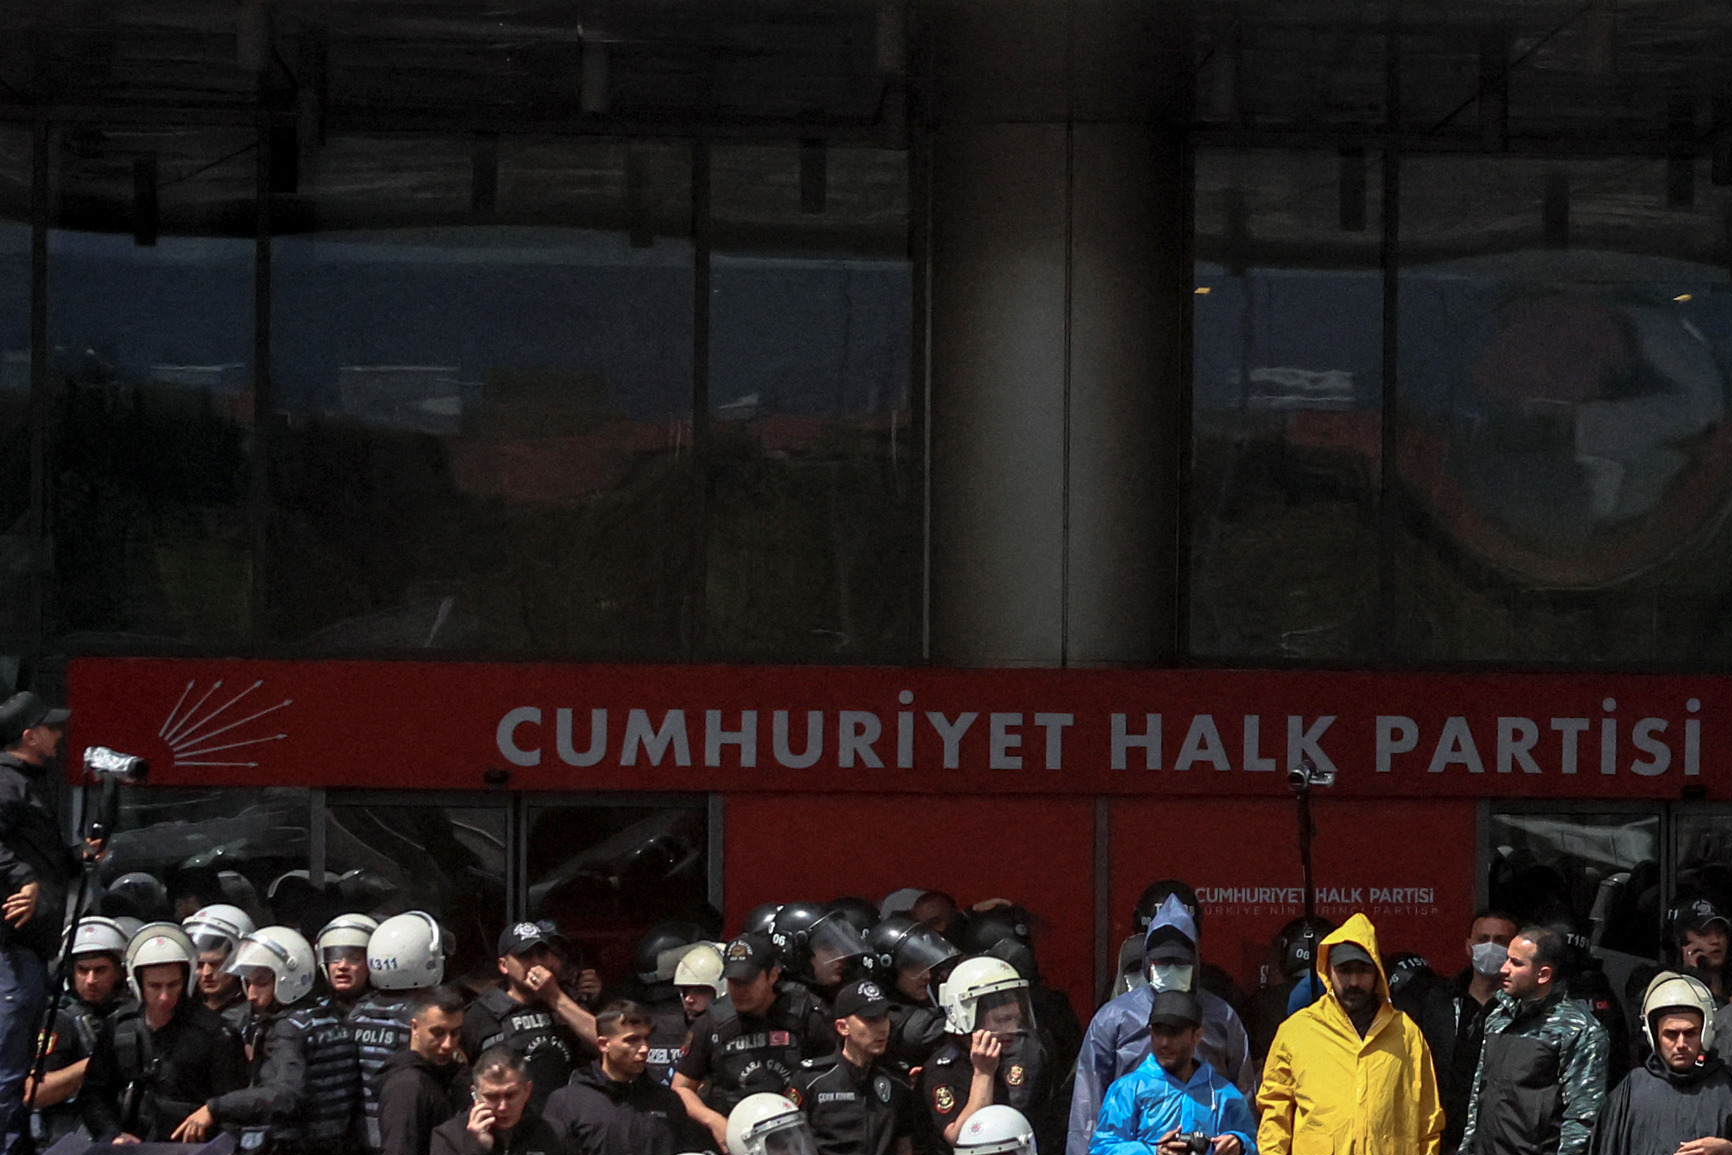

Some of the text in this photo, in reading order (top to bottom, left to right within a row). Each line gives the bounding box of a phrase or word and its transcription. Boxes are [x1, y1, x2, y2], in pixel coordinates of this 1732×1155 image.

[497, 690, 1702, 776] CUMHURİYET HALK PARTİSİ
[1315, 888, 1363, 904] HALK
[773, 933, 786, 947] 06
